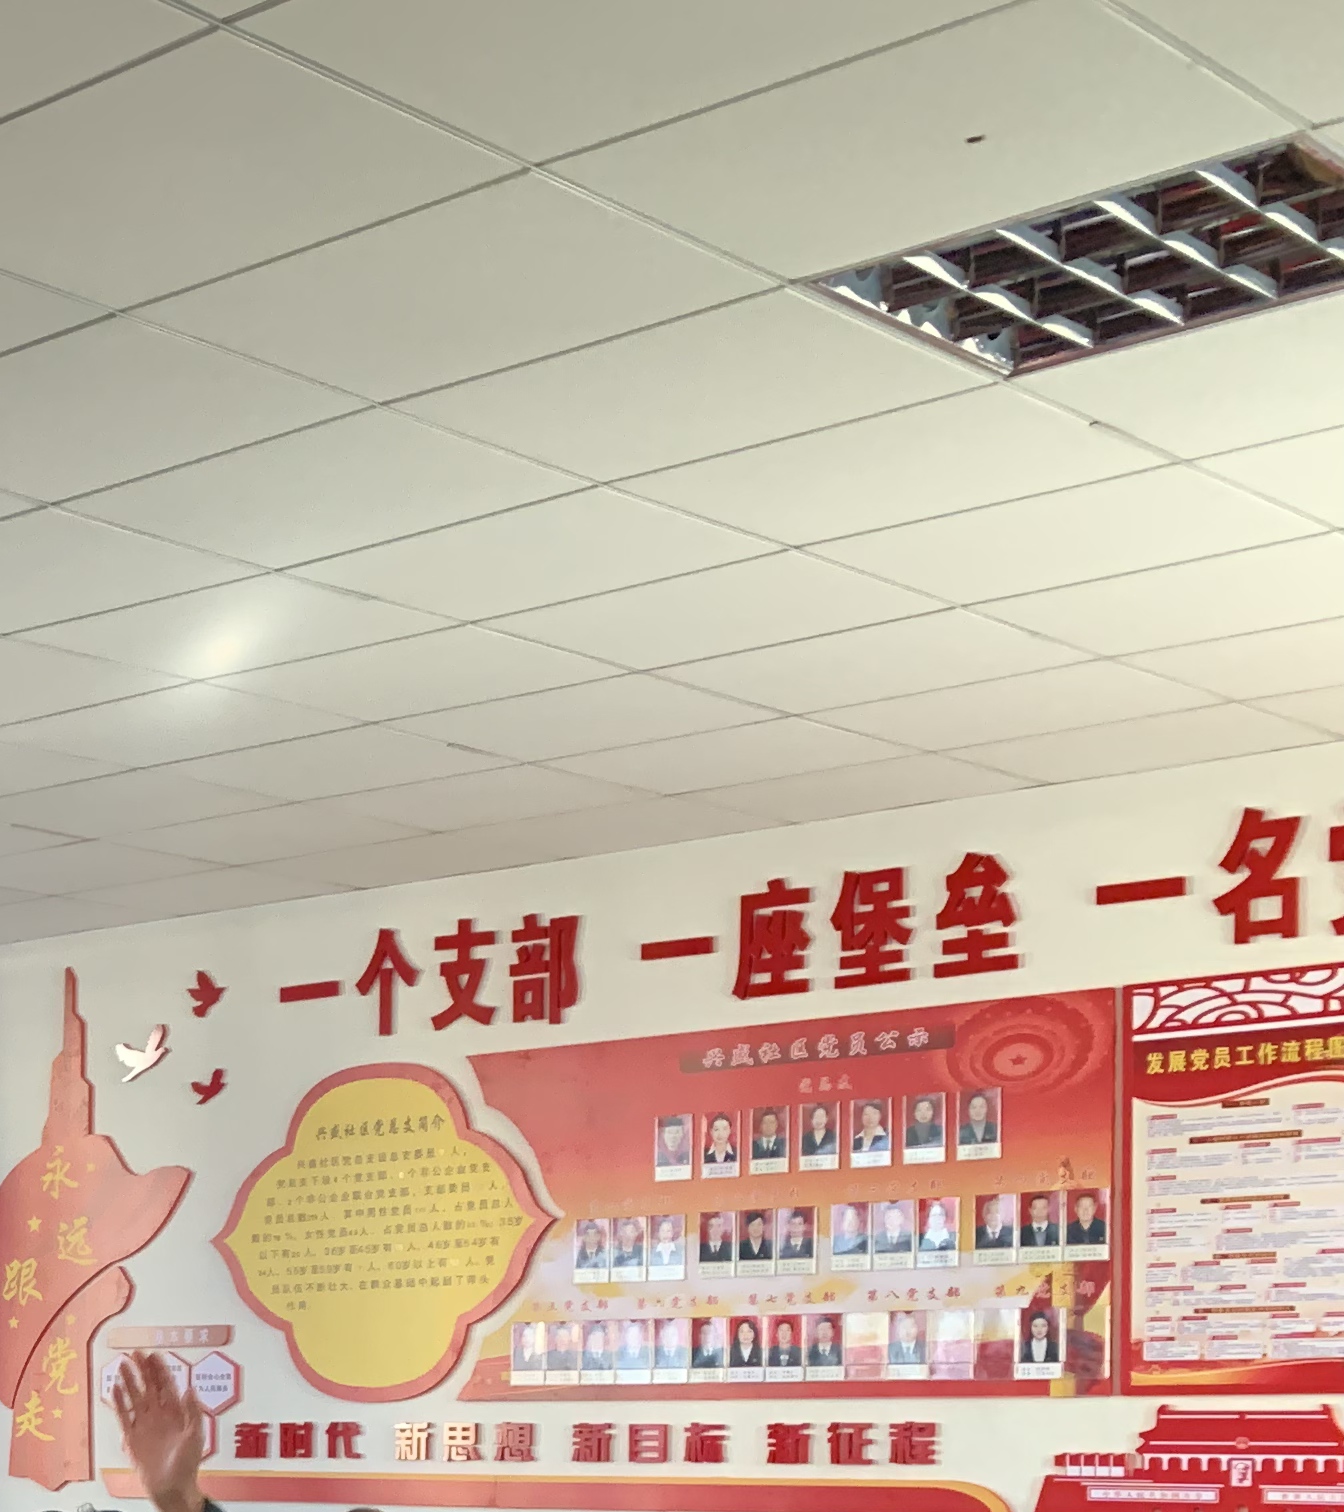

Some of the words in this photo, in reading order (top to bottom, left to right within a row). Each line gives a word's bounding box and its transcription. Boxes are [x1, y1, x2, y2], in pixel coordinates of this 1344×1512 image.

[278, 912, 580, 1036] 一个支部
[640, 852, 1024, 1000] 一座堡垒
[1095, 806, 1344, 945] 一名
[2, 1143, 100, 1443] 永远跟党走
[234, 1421, 364, 1460] 新时代
[392, 1421, 537, 1462] 新思想
[571, 1422, 730, 1464] 新目标
[766, 1421, 942, 1465] 新征程
